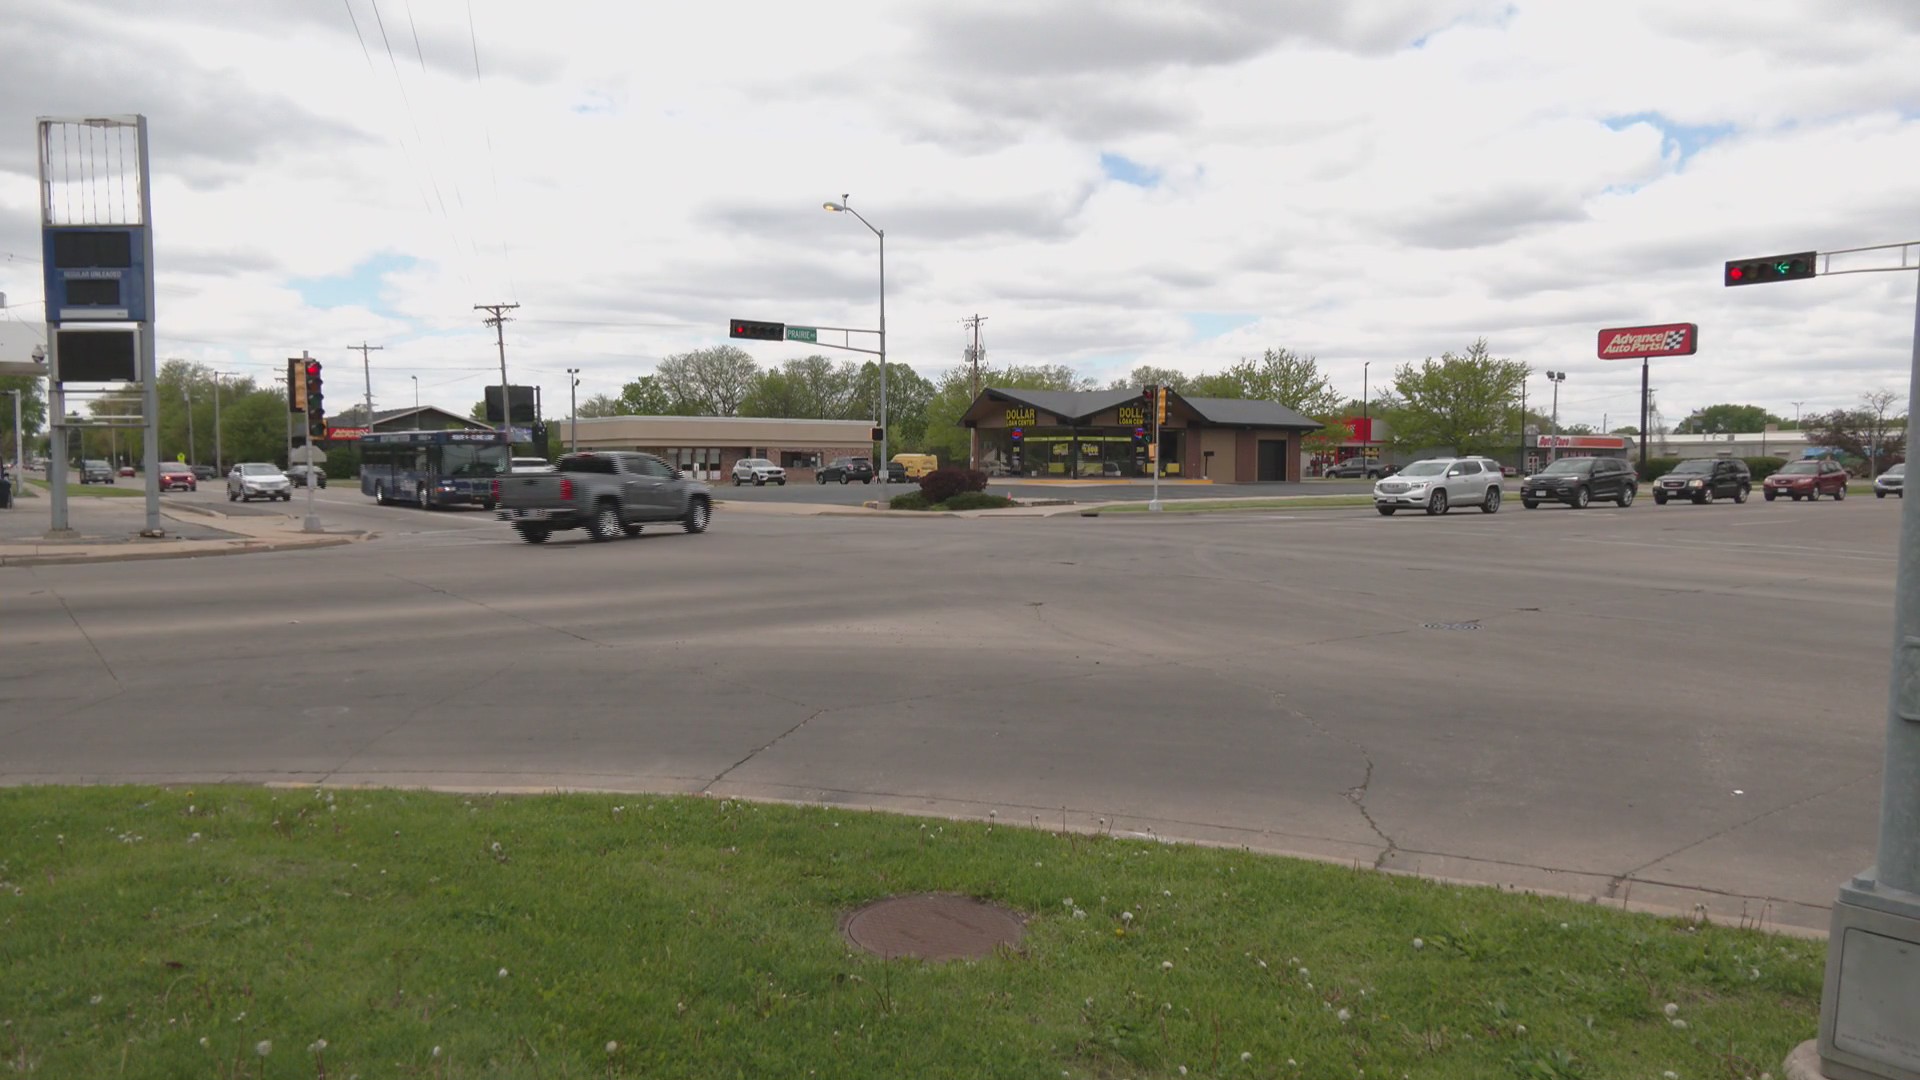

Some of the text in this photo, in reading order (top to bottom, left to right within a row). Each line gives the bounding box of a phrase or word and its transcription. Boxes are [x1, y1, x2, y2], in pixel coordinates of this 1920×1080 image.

[90, 271, 122, 279] UNLEADED
[787, 329, 810, 340] PRAIRIE
[1611, 333, 1663, 345] Advance
[1603, 341, 1660, 354] Auto Parts
[1006, 408, 1035, 420] DOLLAR
[1119, 407, 1144, 418] DOLL
[1006, 419, 1035, 427] LOAN CENTER
[1538, 436, 1570, 447] AutZone
